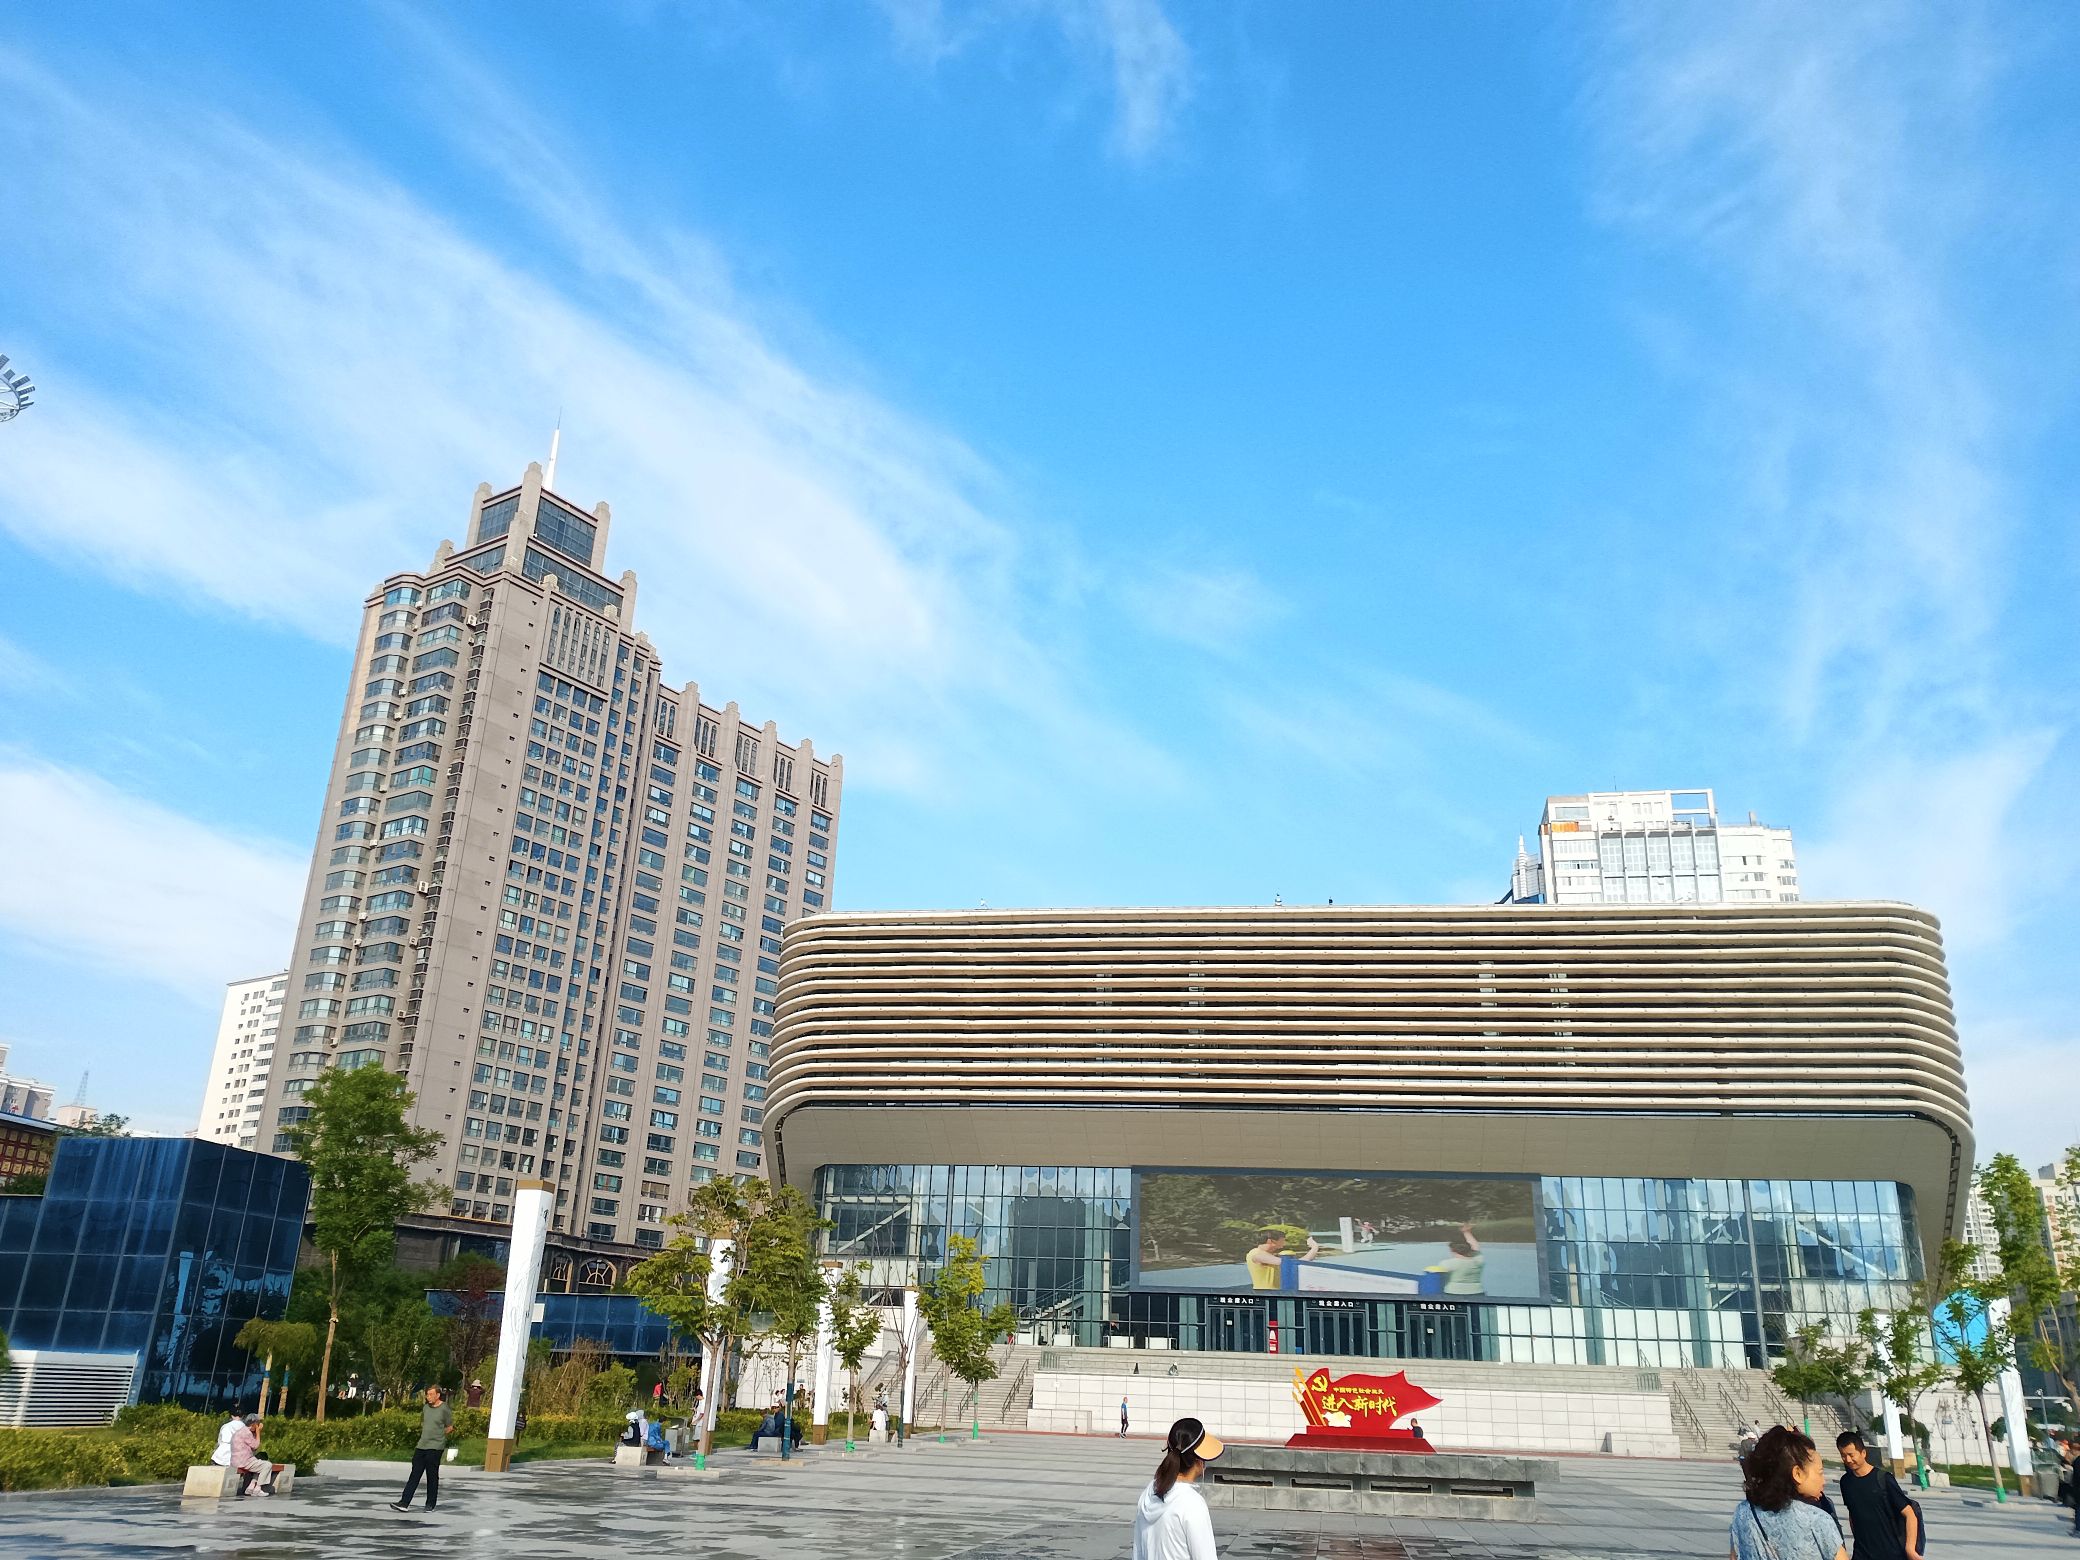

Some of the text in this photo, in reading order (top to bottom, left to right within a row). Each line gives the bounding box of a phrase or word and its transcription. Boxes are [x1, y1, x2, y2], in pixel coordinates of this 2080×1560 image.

[1321, 1393, 1398, 1418] 进入新时代
